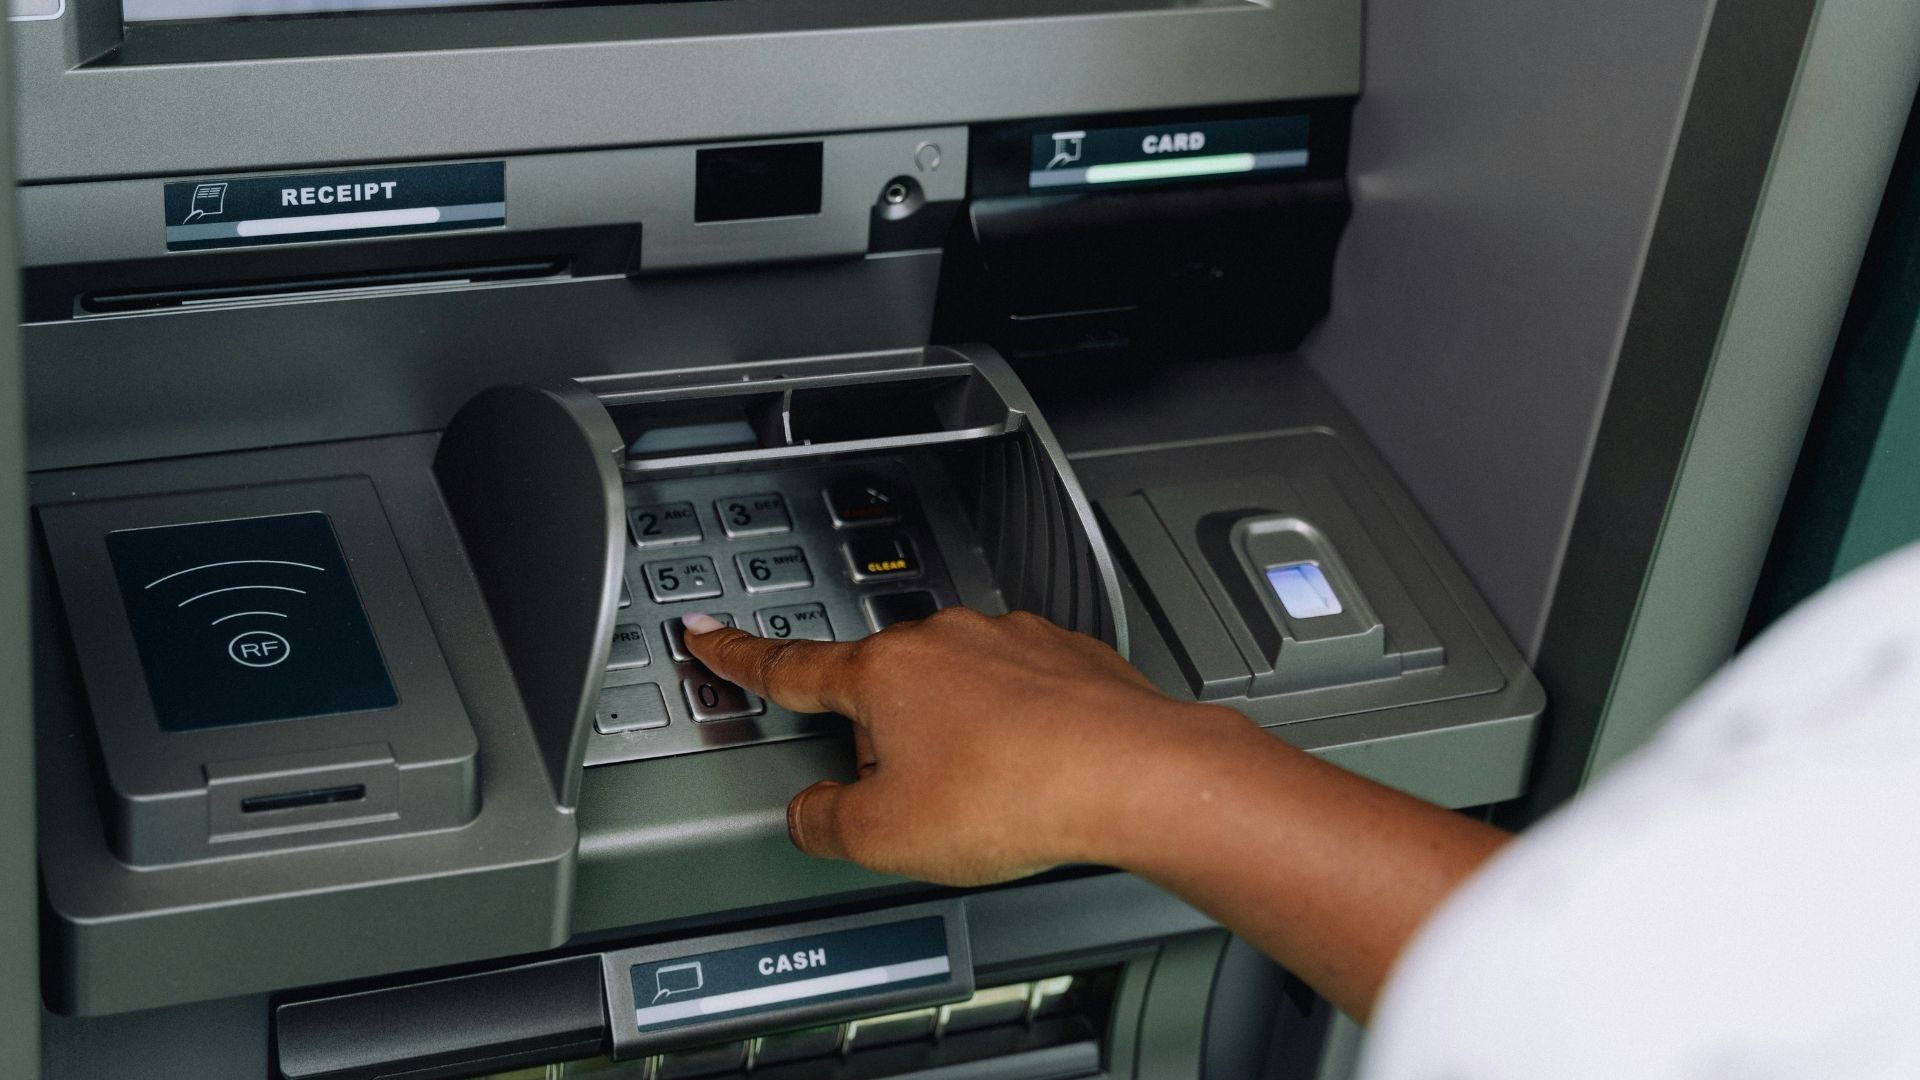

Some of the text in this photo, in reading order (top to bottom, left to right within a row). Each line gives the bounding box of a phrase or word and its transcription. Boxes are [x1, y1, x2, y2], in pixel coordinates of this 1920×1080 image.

[1141, 131, 1205, 154] CARD
[281, 181, 397, 207] RECEIPT
[638, 508, 692, 536] 2 ABC
[728, 503, 751, 526] 3
[658, 564, 708, 591] 5 JKL
[749, 557, 771, 581] 6
[867, 560, 906, 572] CLEAR
[769, 614, 791, 638] 9
[240, 641, 278, 658] RF
[698, 683, 719, 708] 0
[758, 947, 827, 976] CASH
